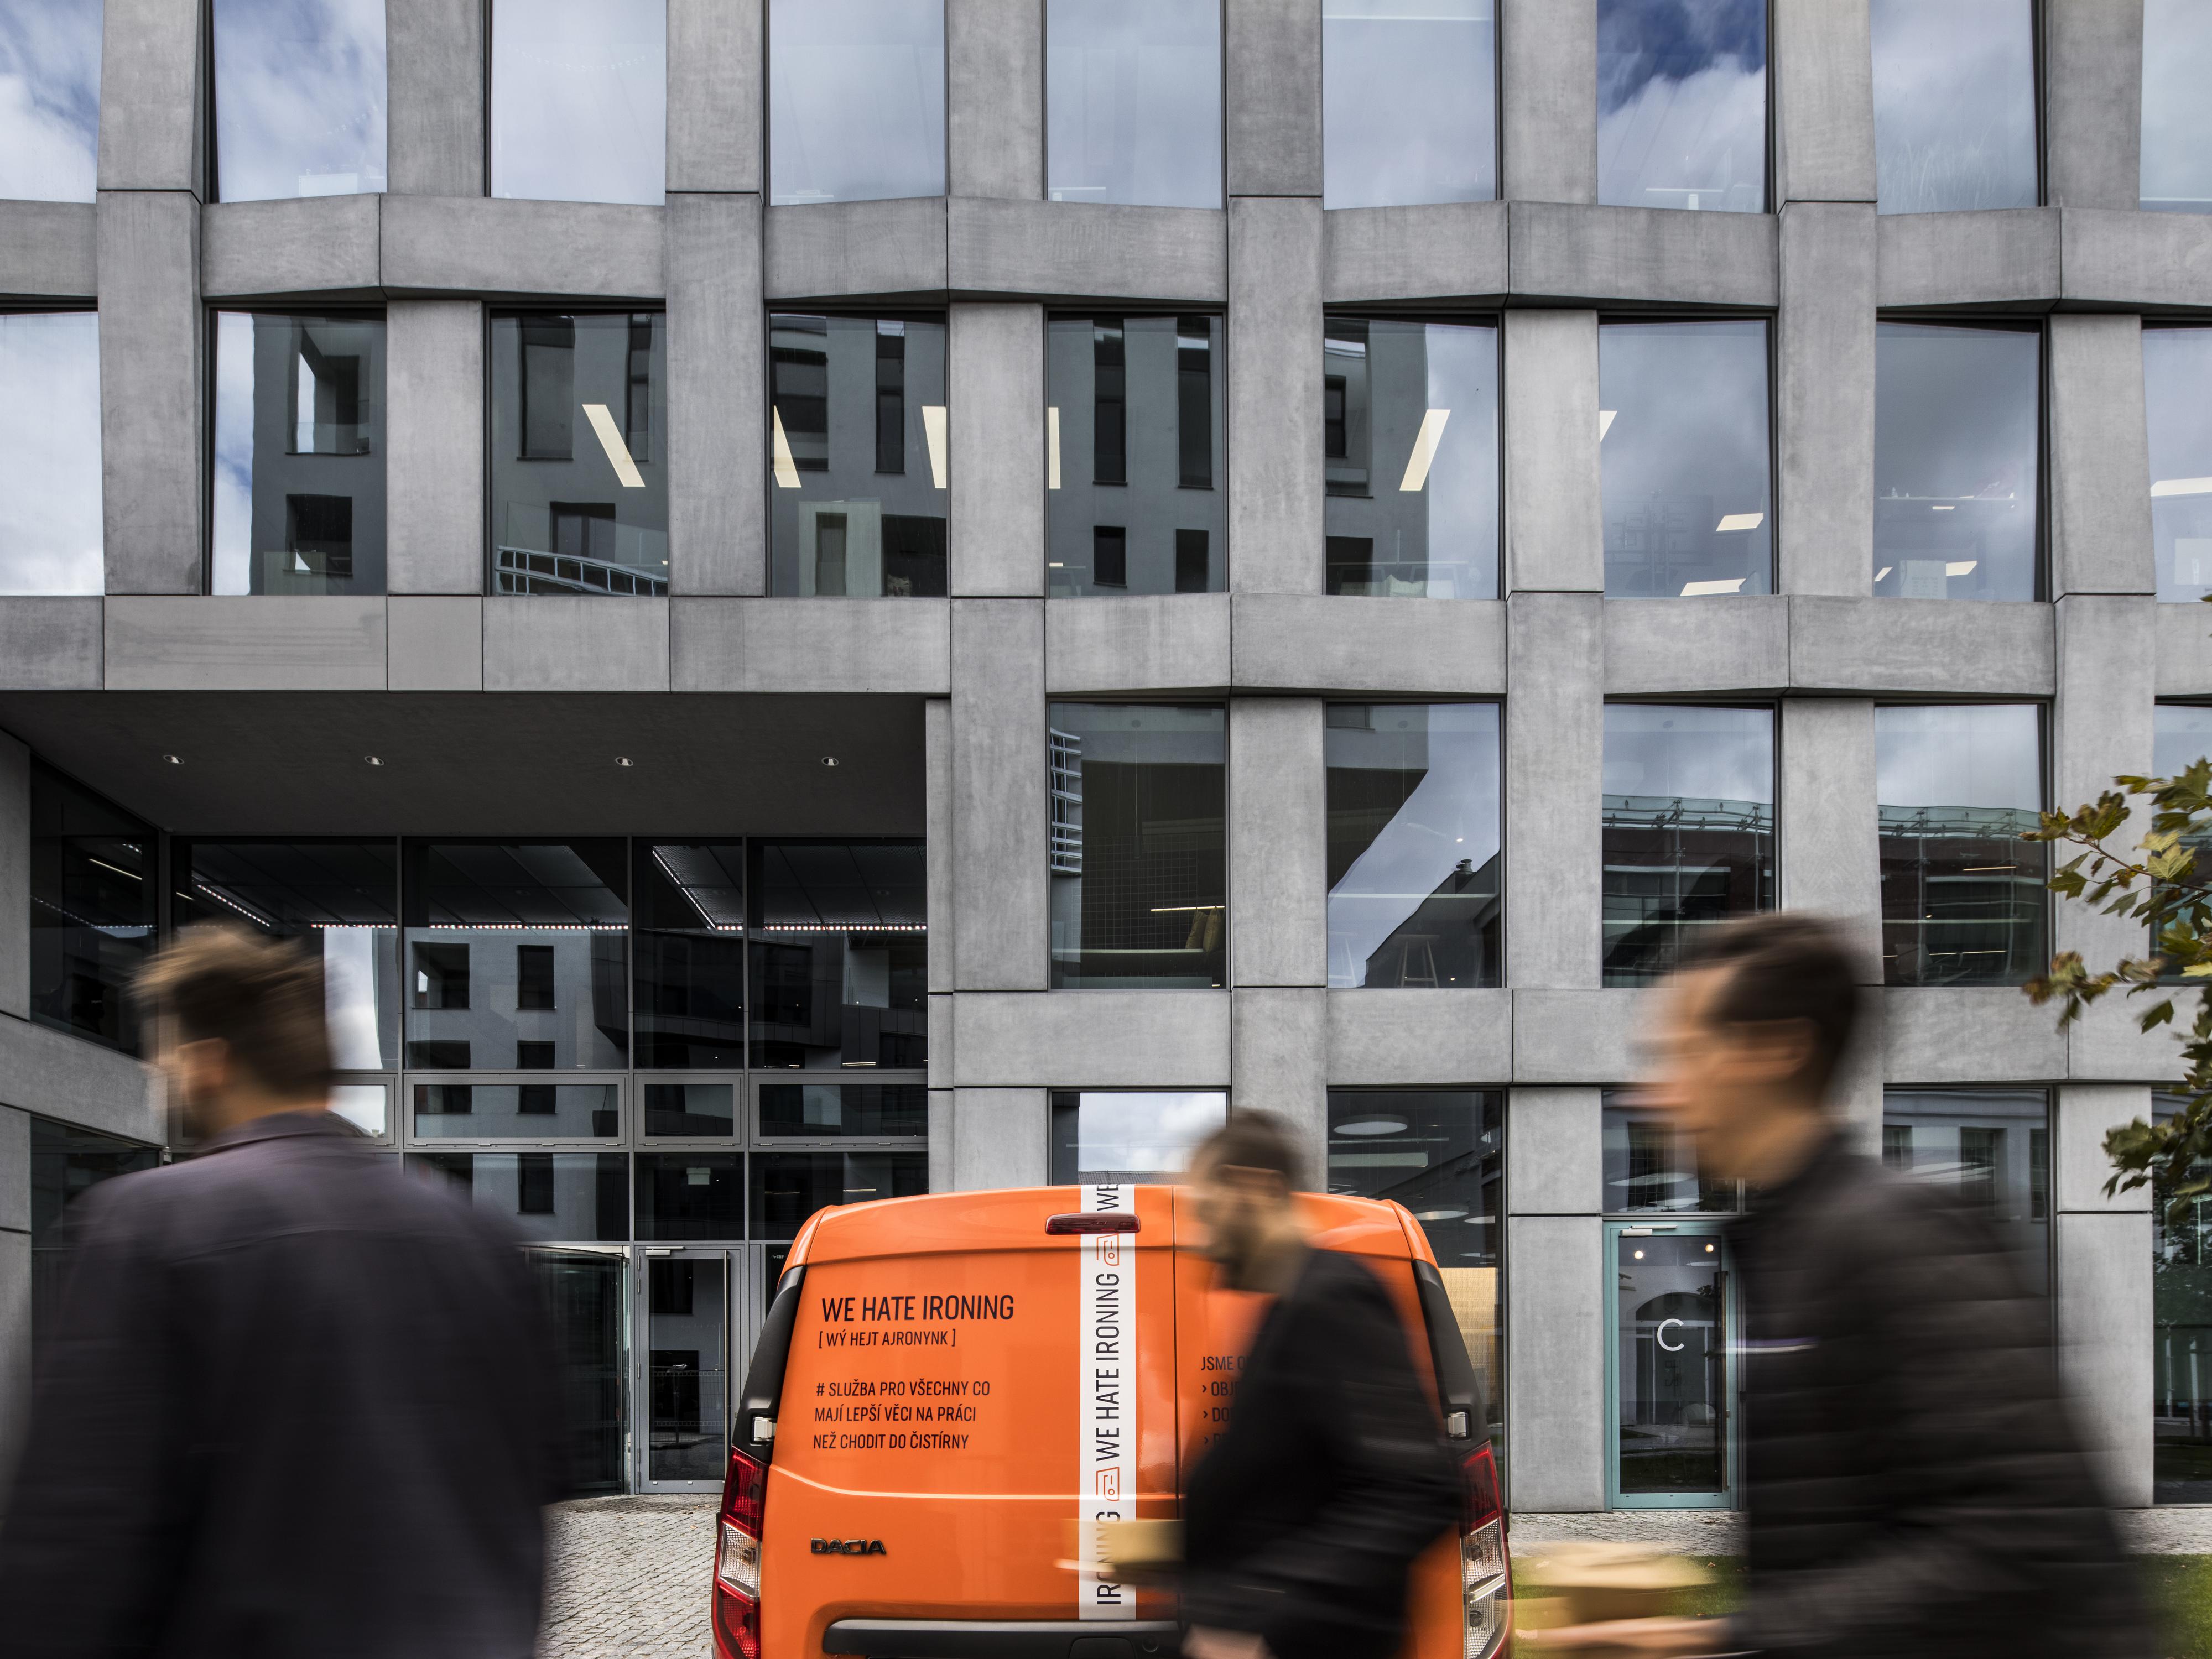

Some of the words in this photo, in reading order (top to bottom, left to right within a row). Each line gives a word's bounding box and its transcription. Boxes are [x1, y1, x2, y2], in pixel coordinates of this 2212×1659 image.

[1097, 1185, 1119, 1211] WE
[822, 1297, 855, 1322] WE
[862, 1296, 915, 1321] HATE
[923, 1295, 1013, 1320] IRONING
[1096, 1274, 1120, 1360] IRONING
[826, 1329, 846, 1346] WÝ
[851, 1332, 879, 1345] HEJT
[882, 1331, 948, 1345] AJRONYNK
[1657, 1318, 1684, 1352] C
[1201, 1357, 1234, 1370] JSME
[829, 1379, 875, 1396] SLUŽBA
[880, 1381, 905, 1396] PRO
[910, 1379, 968, 1395] VŠECHNY
[973, 1381, 990, 1395] CO
[1096, 1368, 1120, 1419] HATE
[815, 1404, 844, 1421] MAJÍ
[847, 1404, 882, 1421] LEPŠÍ
[885, 1404, 912, 1421] VĚCI
[917, 1407, 933, 1421] NA
[938, 1404, 975, 1421] PRÁCI
[814, 1432, 836, 1449] NEŽ
[841, 1434, 886, 1449] CHODIT
[889, 1434, 906, 1448] DO
[910, 1431, 969, 1449] ČISTÍRNY
[1096, 1427, 1120, 1462] WE
[811, 1538, 886, 1554] DACIA
